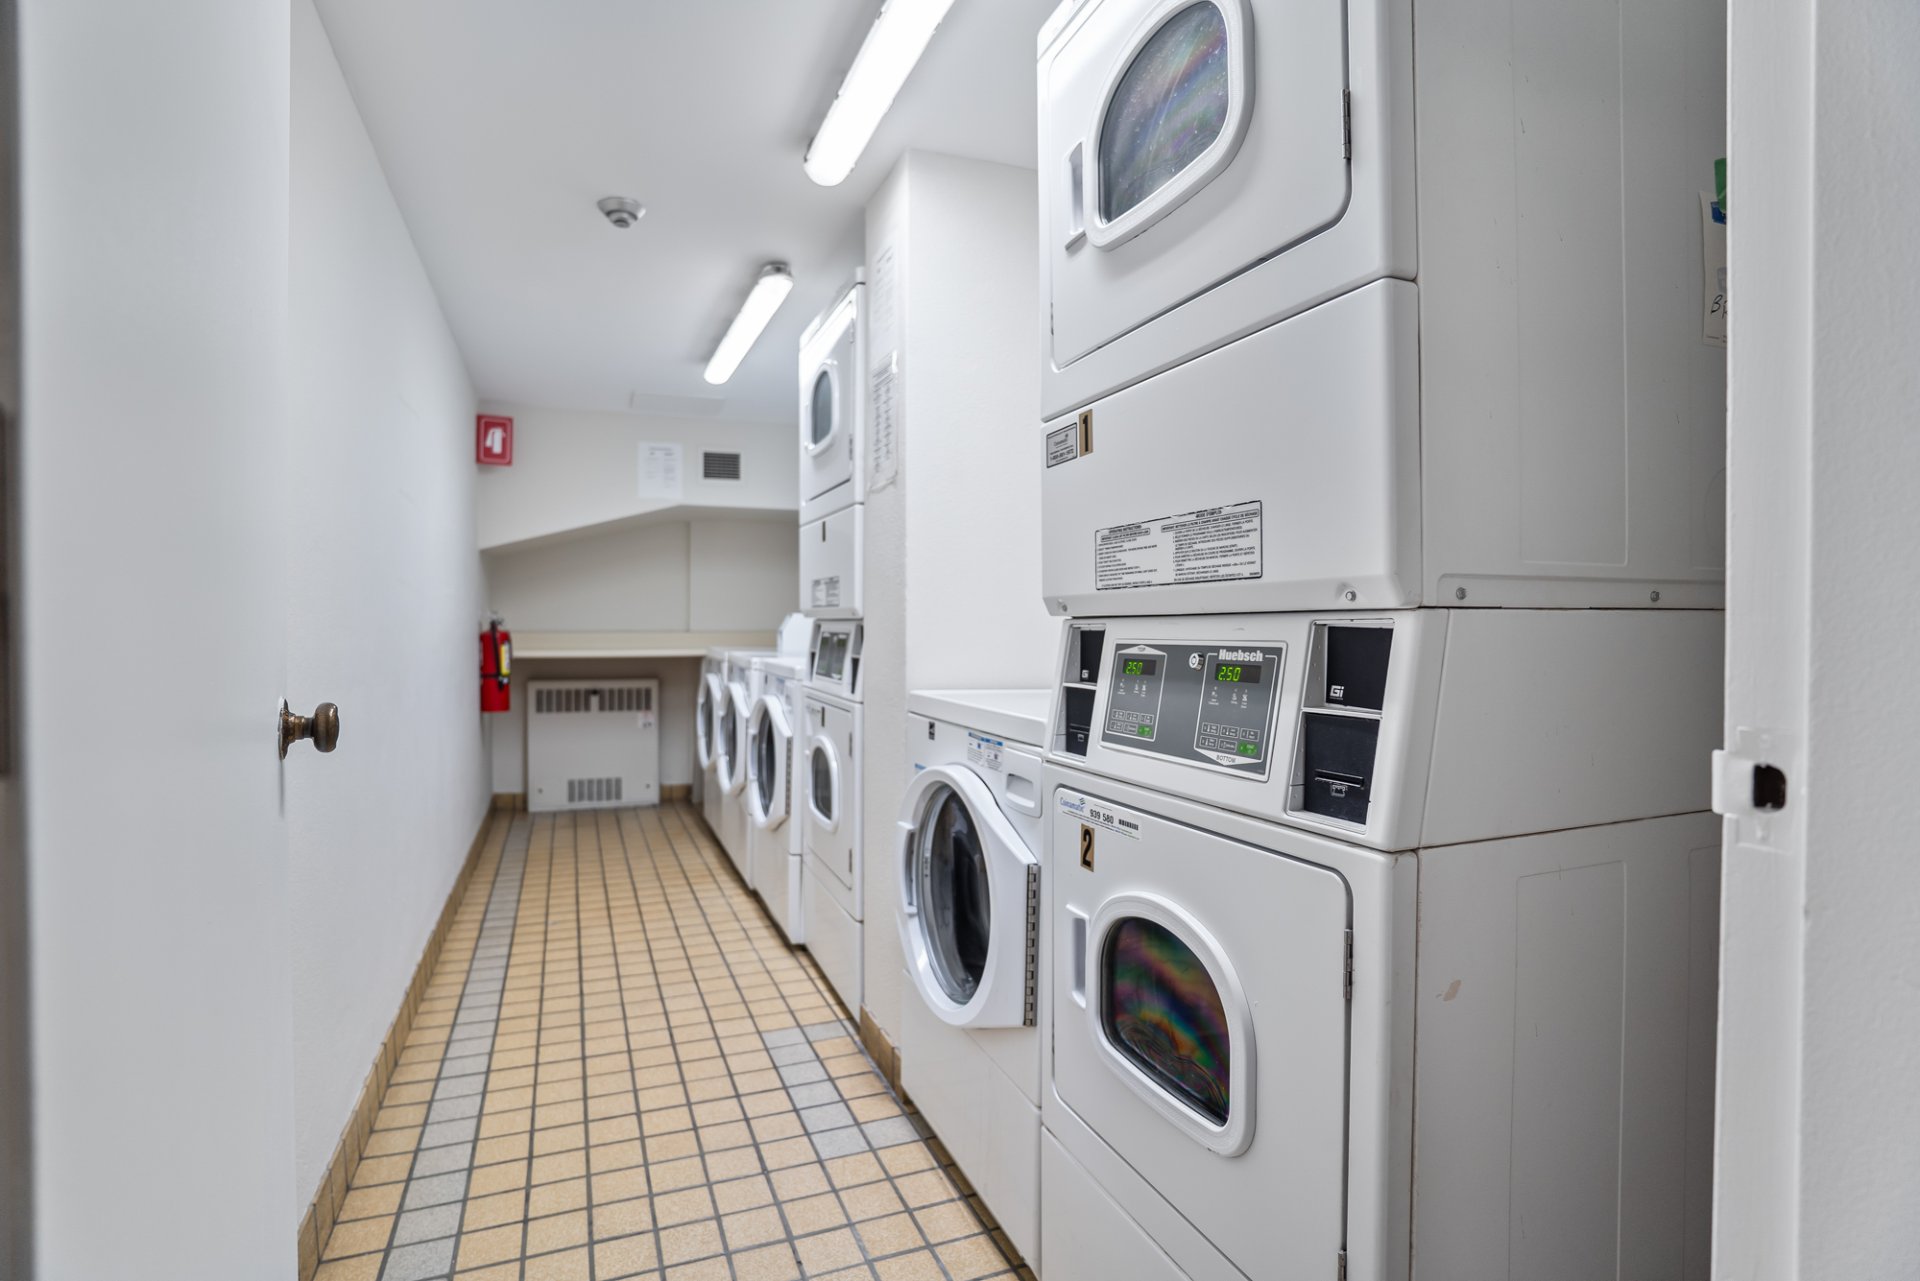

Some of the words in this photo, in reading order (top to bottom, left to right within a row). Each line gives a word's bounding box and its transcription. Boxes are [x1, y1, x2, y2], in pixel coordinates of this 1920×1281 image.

[1082, 414, 1089, 452] 1
[1219, 648, 1263, 662] Huebsch
[1218, 666, 1241, 681] 2.50
[1329, 685, 1344, 697] Gi
[1216, 754, 1237, 764] BOTTOM
[1083, 828, 1092, 868] 2
